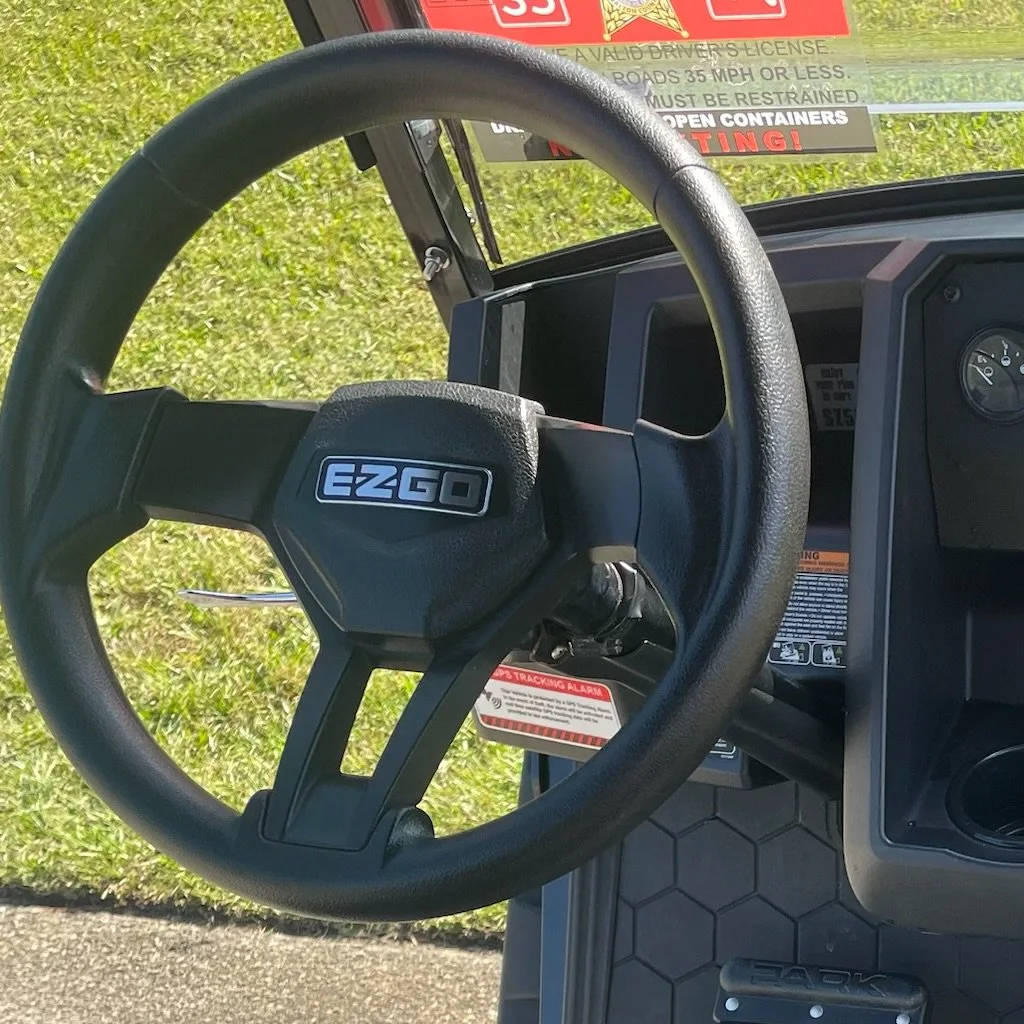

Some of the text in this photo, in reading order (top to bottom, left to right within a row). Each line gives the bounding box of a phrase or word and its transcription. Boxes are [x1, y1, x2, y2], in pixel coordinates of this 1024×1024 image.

[574, 48, 588, 62] A
[590, 45, 644, 61] VALID
[651, 41, 738, 60] DRIVER'S
[744, 39, 835, 56] LICENSE.
[613, 64, 851, 87] ROADS 35 MPH OR LESS.
[647, 94, 697, 109] MUST
[702, 92, 732, 107] BE
[662, 110, 849, 129] OPEN CONTAINERS
[513, 672, 565, 690] TRACKING
[567, 682, 603, 697] ALARM
